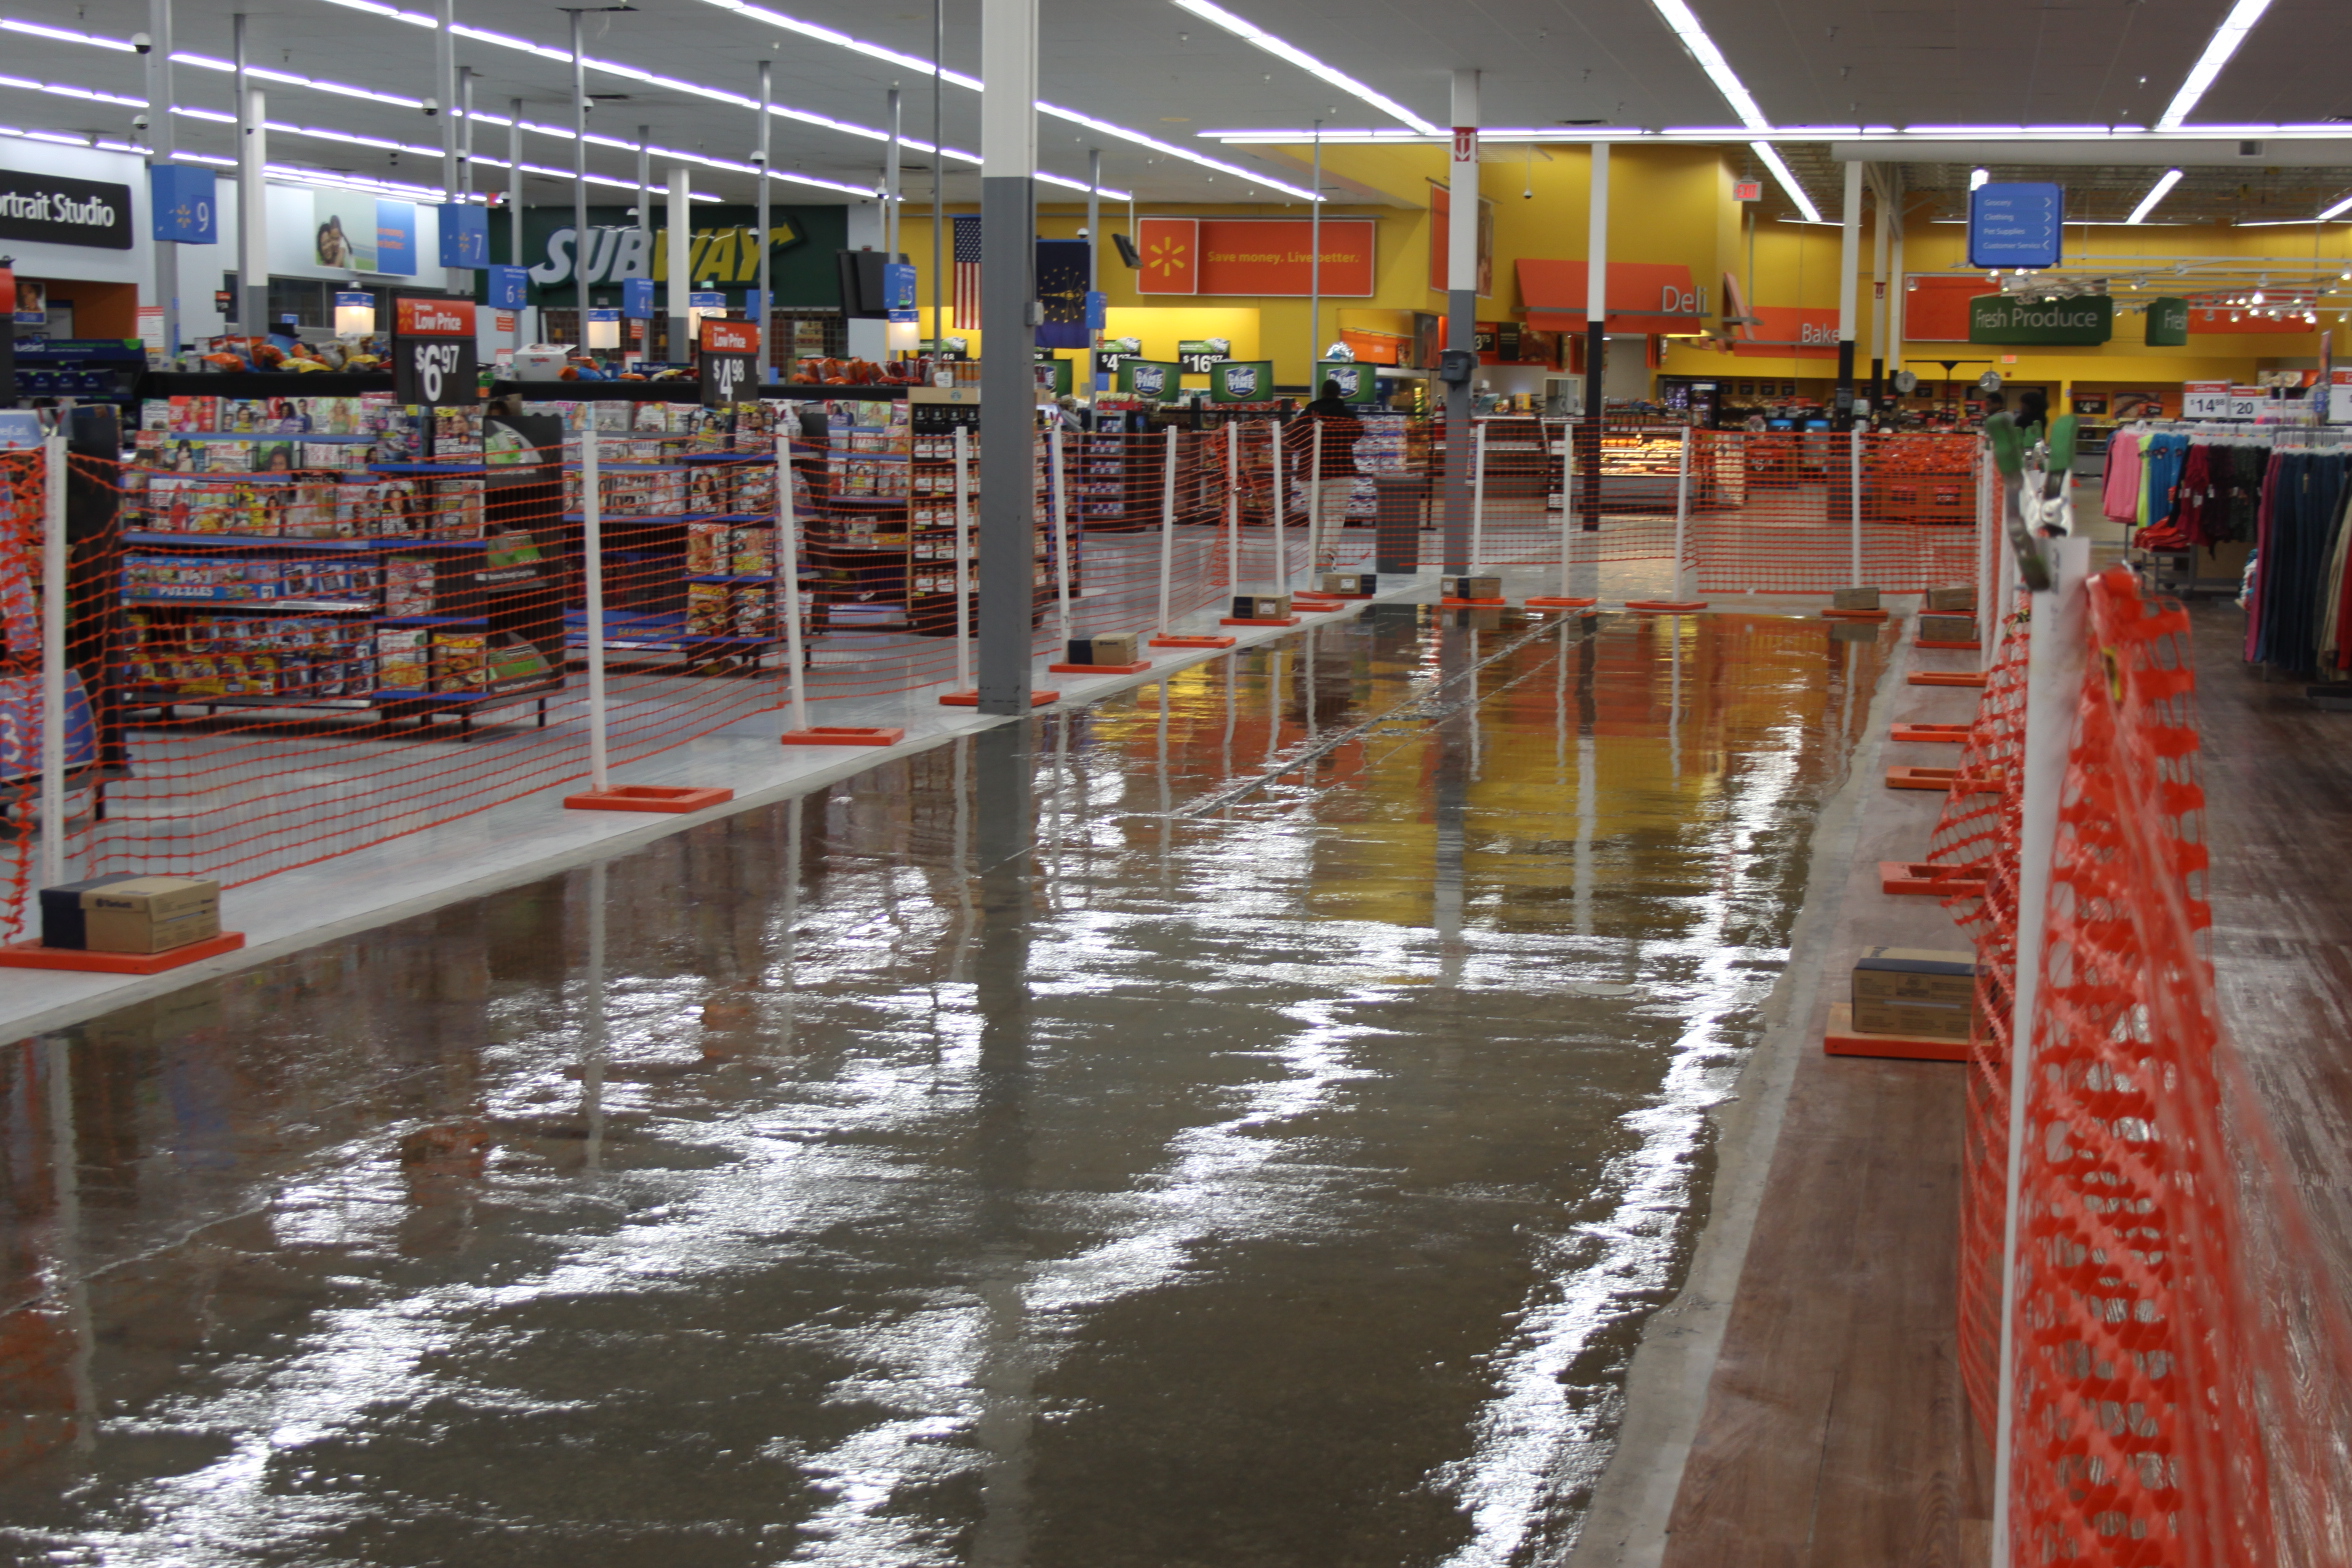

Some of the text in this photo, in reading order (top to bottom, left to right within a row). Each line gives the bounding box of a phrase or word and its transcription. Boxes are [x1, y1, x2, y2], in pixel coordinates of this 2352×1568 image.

[1737, 184, 1758, 198] EXIT
[0, 191, 115, 227] rtrait Studio
[196, 201, 210, 233] 9
[1984, 213, 2015, 222] Clothing
[473, 234, 483, 260] 7
[528, 222, 796, 287] SUBWAY
[1207, 251, 1236, 262] Save
[1239, 253, 1285, 265] money.
[1287, 251, 1314, 263] Live
[506, 285, 515, 303] 6
[1662, 285, 1708, 313] Deli
[414, 311, 462, 331] Low Price
[1975, 306, 2098, 328] Fresh Produce
[713, 332, 746, 348] Low Price
